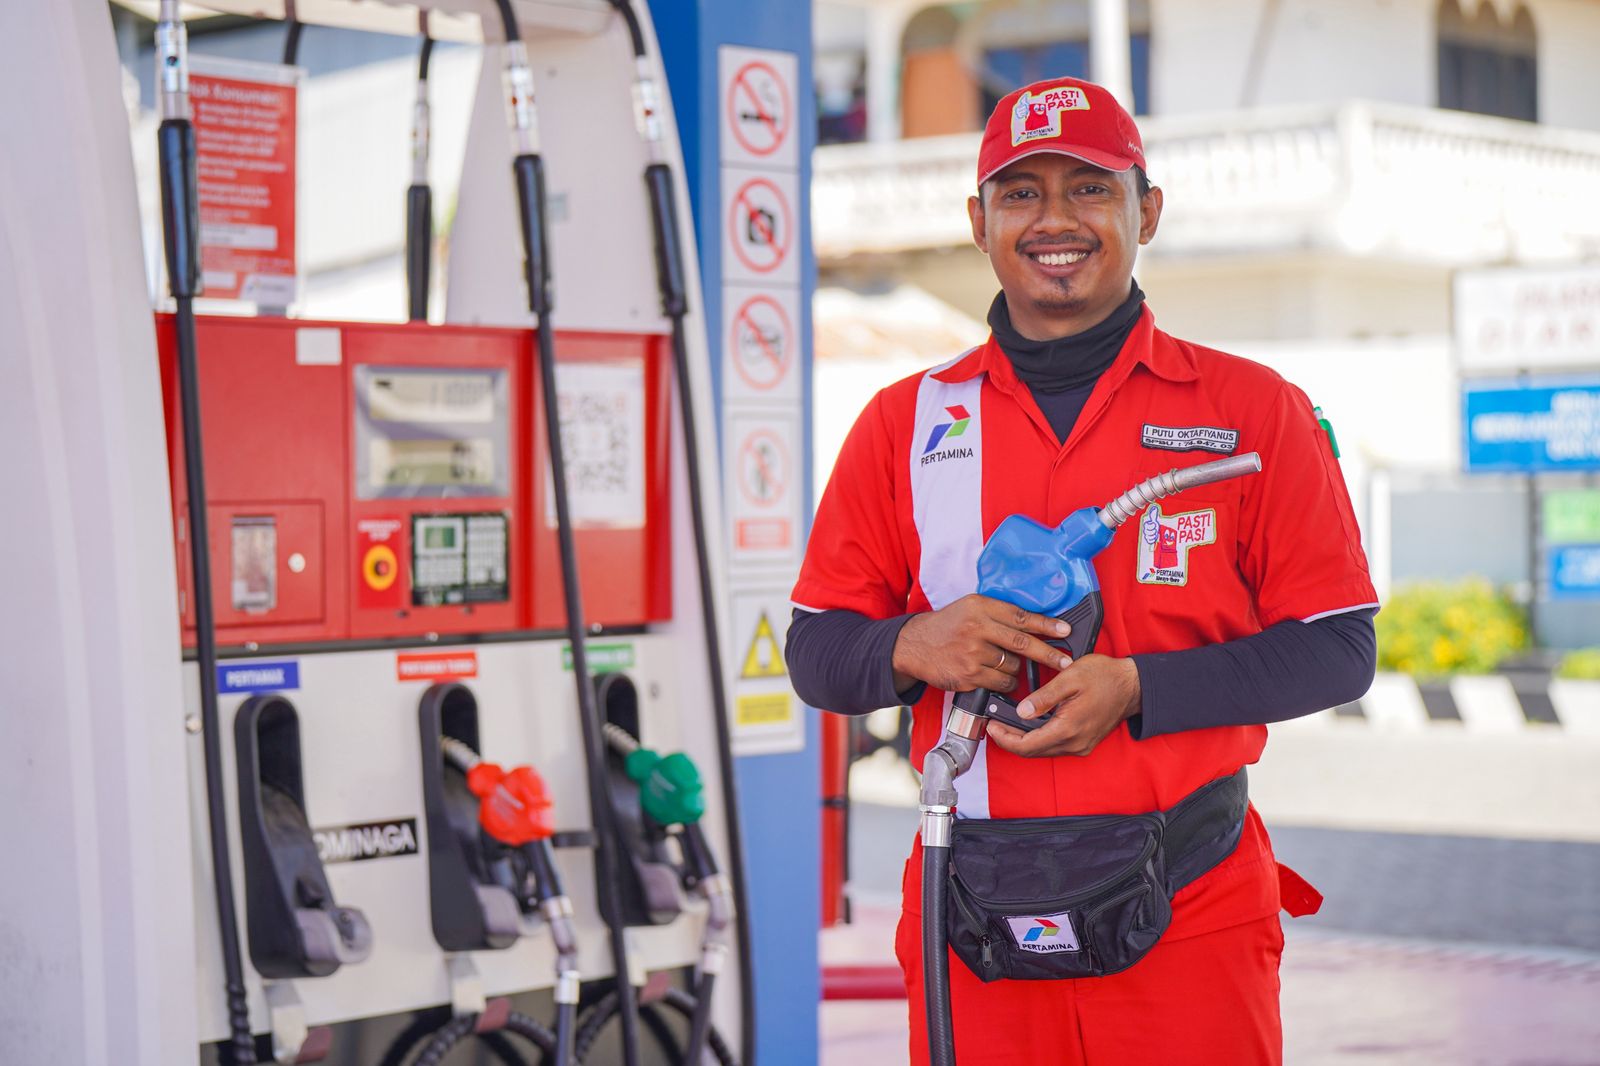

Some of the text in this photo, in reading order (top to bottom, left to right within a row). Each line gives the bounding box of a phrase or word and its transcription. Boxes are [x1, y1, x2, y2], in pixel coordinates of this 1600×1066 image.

[1045, 90, 1079, 103] PASTI
[1048, 99, 1077, 111] PAS!
[1145, 426, 1234, 441] I PUTU OKTAFIYANUS
[920, 447, 974, 467] PERTAMINA
[1177, 513, 1210, 530] PASTI
[1156, 569, 1184, 578] PERTAMINA
[312, 823, 417, 860] OMINAGA
[1021, 943, 1074, 952] PERTAMINA
